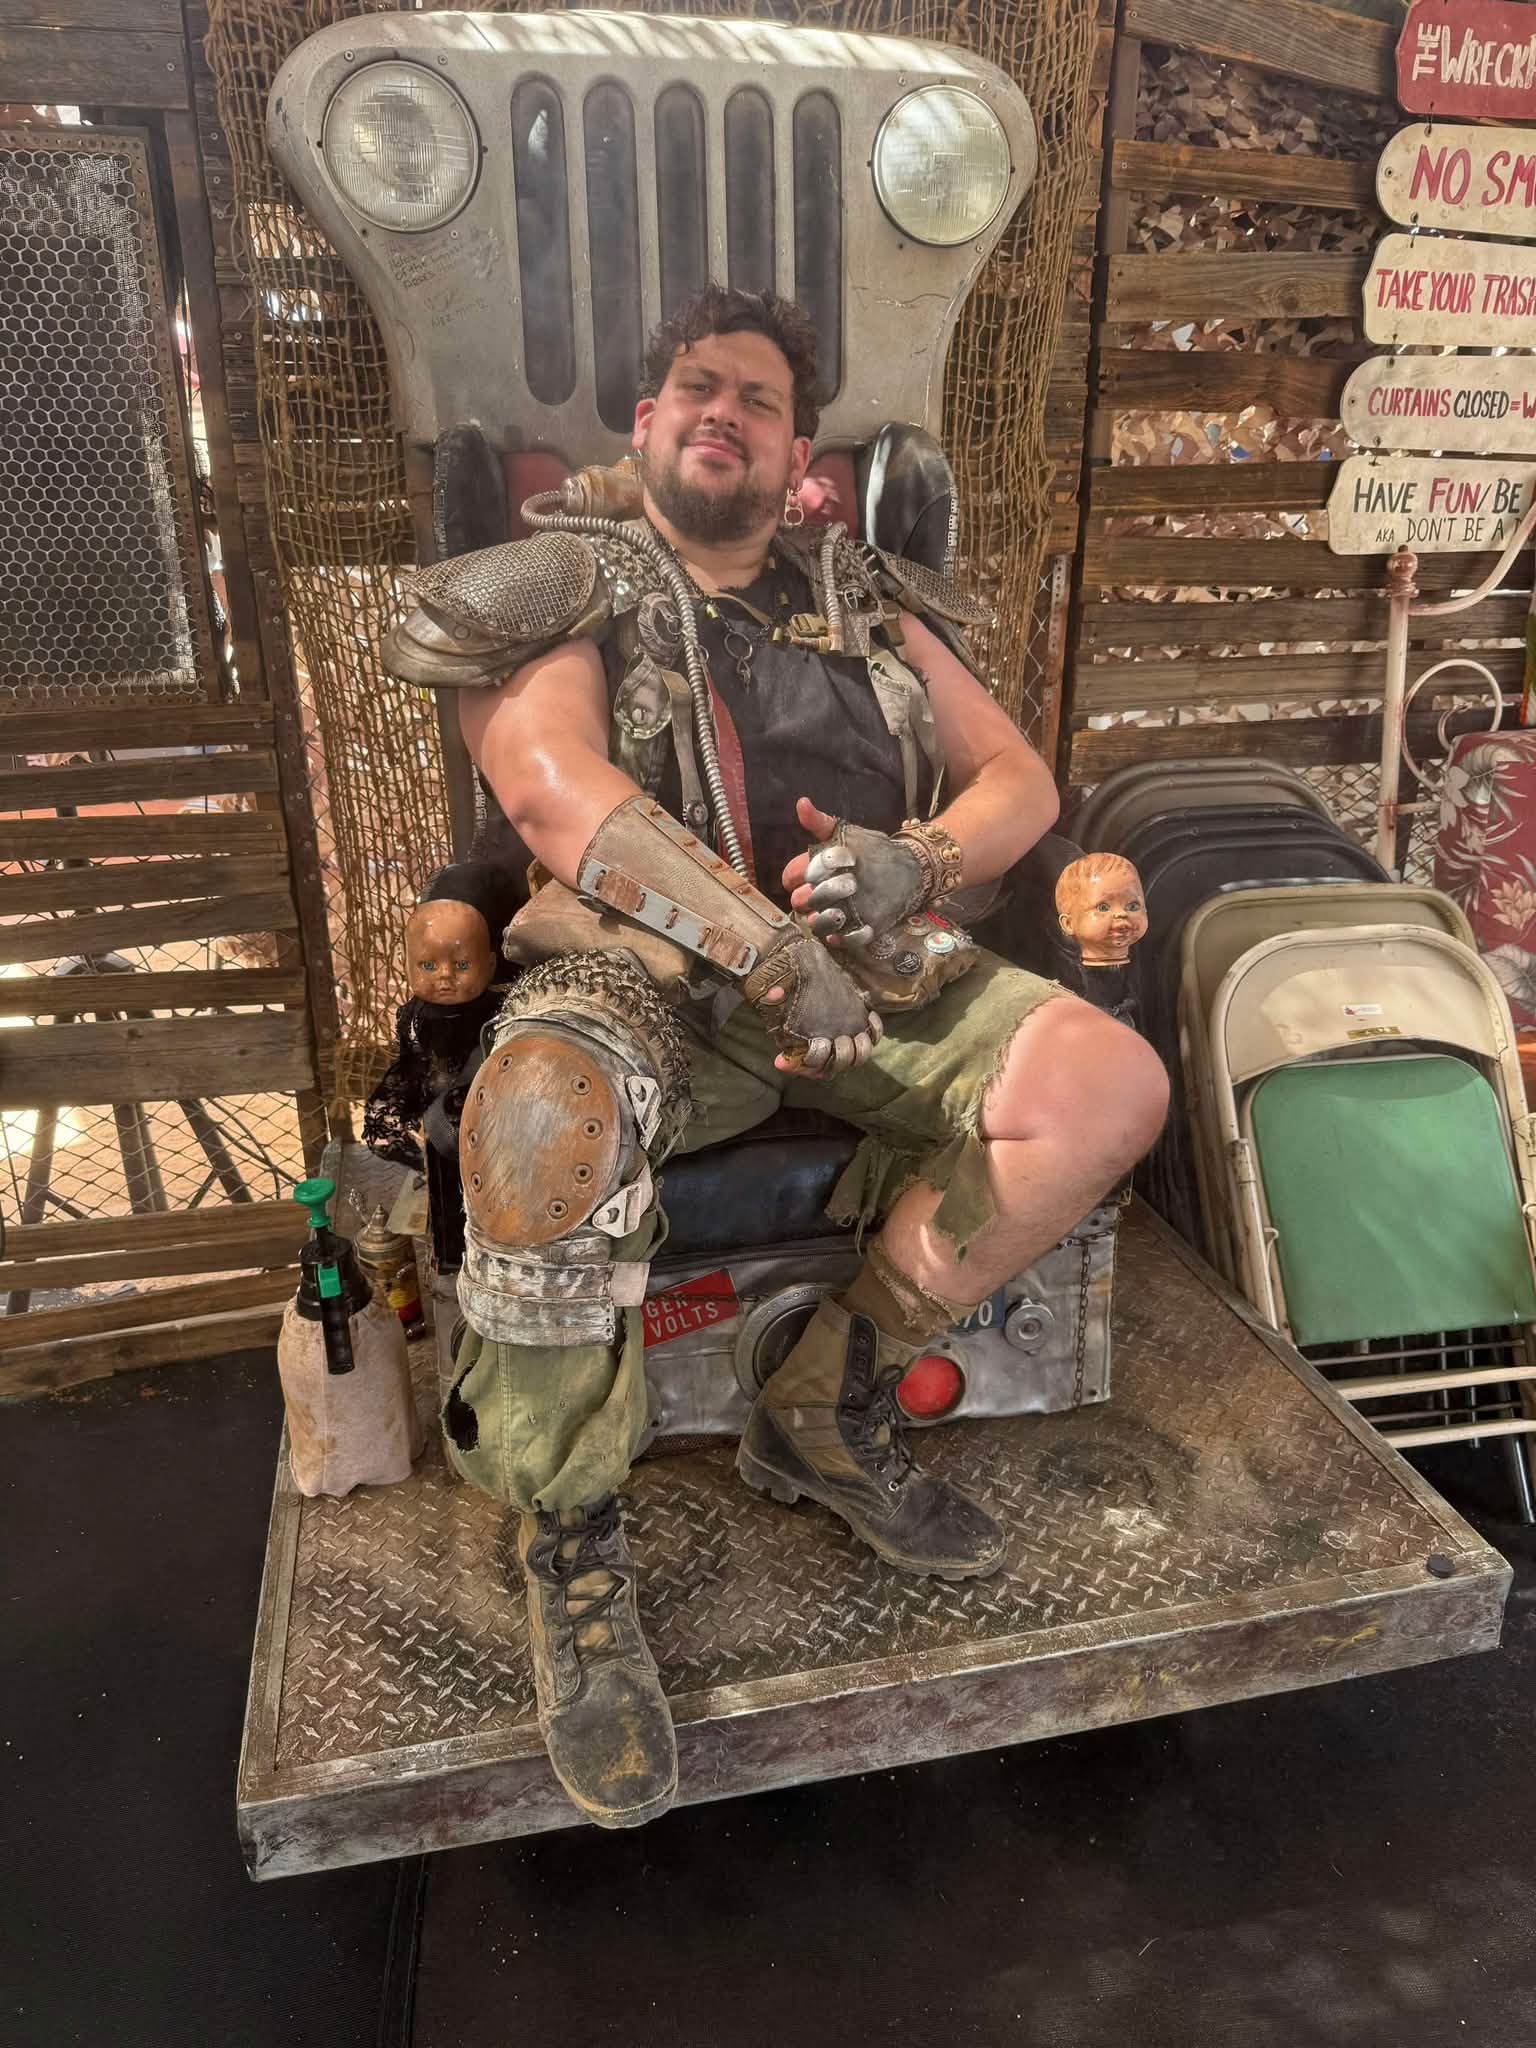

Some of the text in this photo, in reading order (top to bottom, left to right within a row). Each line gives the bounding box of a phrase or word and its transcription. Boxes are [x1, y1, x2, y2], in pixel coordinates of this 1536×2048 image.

[1412, 23, 1441, 80] THE
[1408, 144, 1536, 208] NO SM
[1376, 269, 1536, 316] TAKE YOUR TRASH
[1368, 387, 1451, 417] CURTAINS
[1353, 477, 1418, 514] HAVE
[1375, 528, 1395, 543] AKA
[1405, 517, 1457, 542] DON'T
[1462, 517, 1486, 542] BE
[1491, 517, 1504, 541] A
[645, 1291, 689, 1319] GER
[649, 1301, 719, 1338] VOLTS
